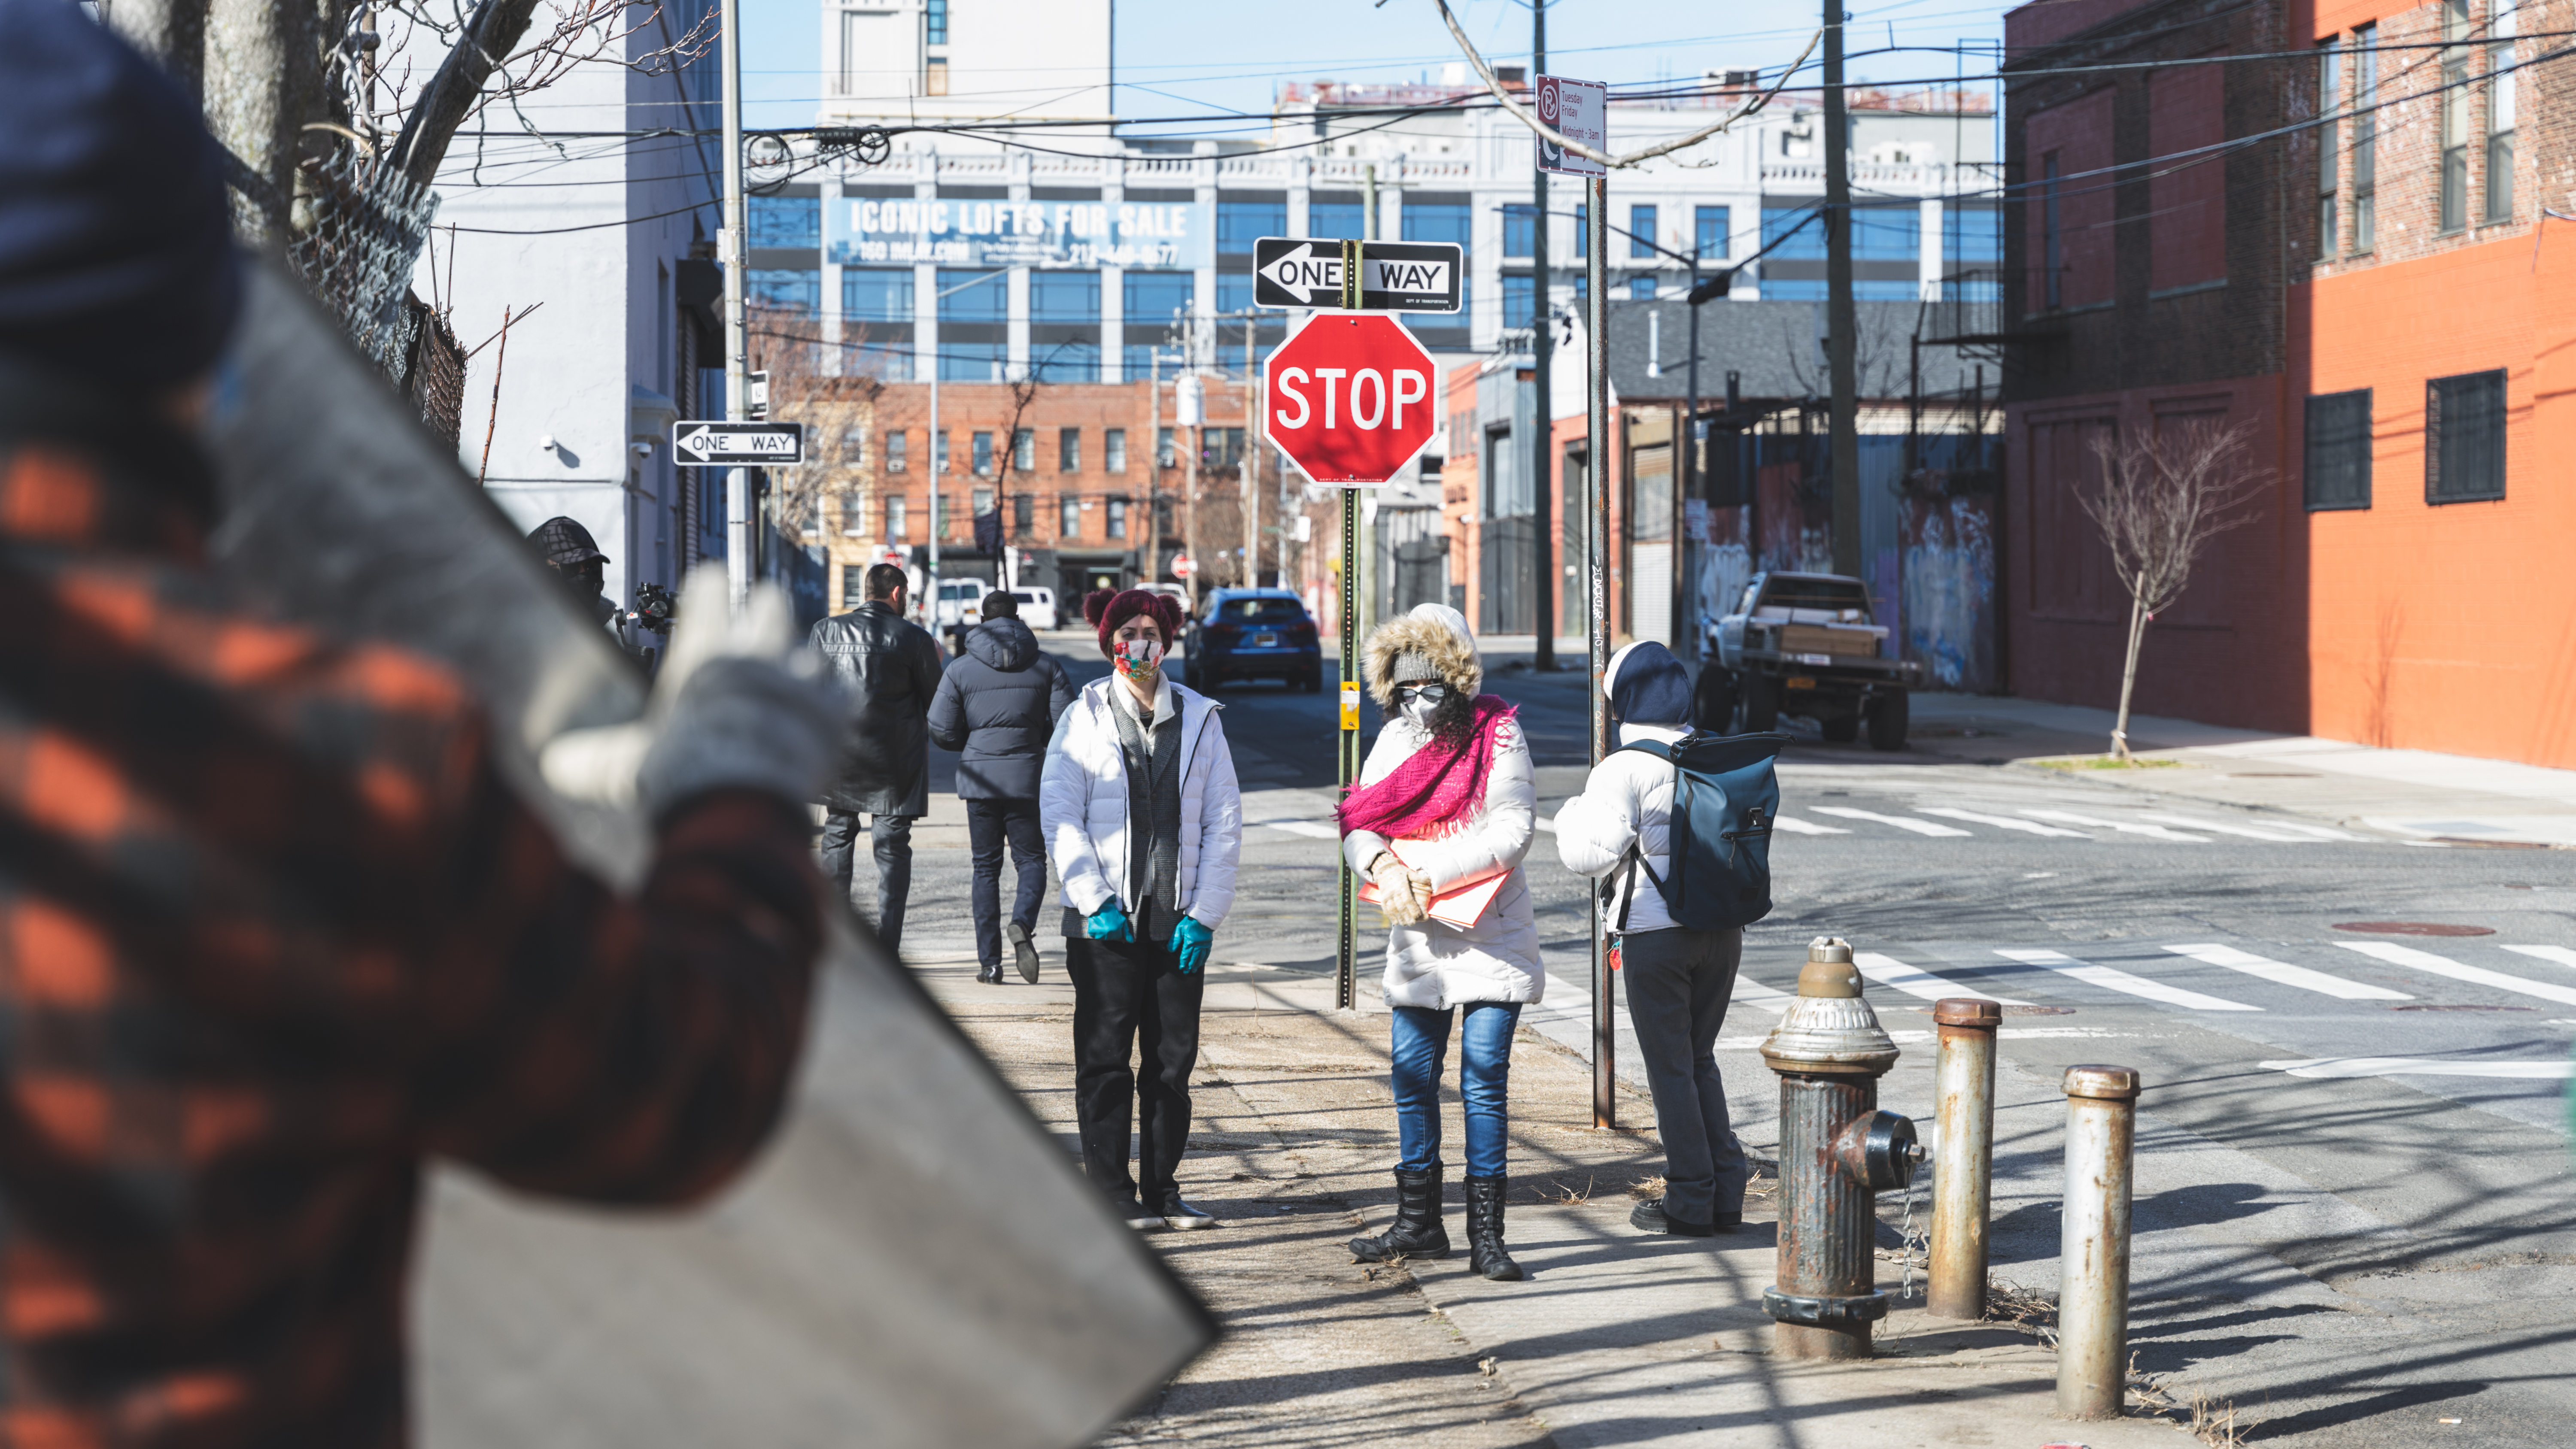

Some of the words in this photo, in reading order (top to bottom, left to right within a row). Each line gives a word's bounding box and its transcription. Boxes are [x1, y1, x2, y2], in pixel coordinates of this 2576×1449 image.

[1562, 91, 1583, 106] Tuesday
[1562, 105, 1578, 120] Friday
[1562, 125, 1584, 140] Midnight
[1589, 129, 1600, 140] 3am
[851, 201, 948, 234] ICONIC
[959, 203, 1045, 236] LOFTS
[1055, 204, 1108, 236] FOR
[1118, 206, 1186, 237] SALE
[1279, 260, 1343, 287] ONE
[1379, 264, 1442, 290] WAY
[1276, 367, 1427, 430] STOP
[693, 436, 729, 451] ONE
[751, 436, 790, 451] WAY
